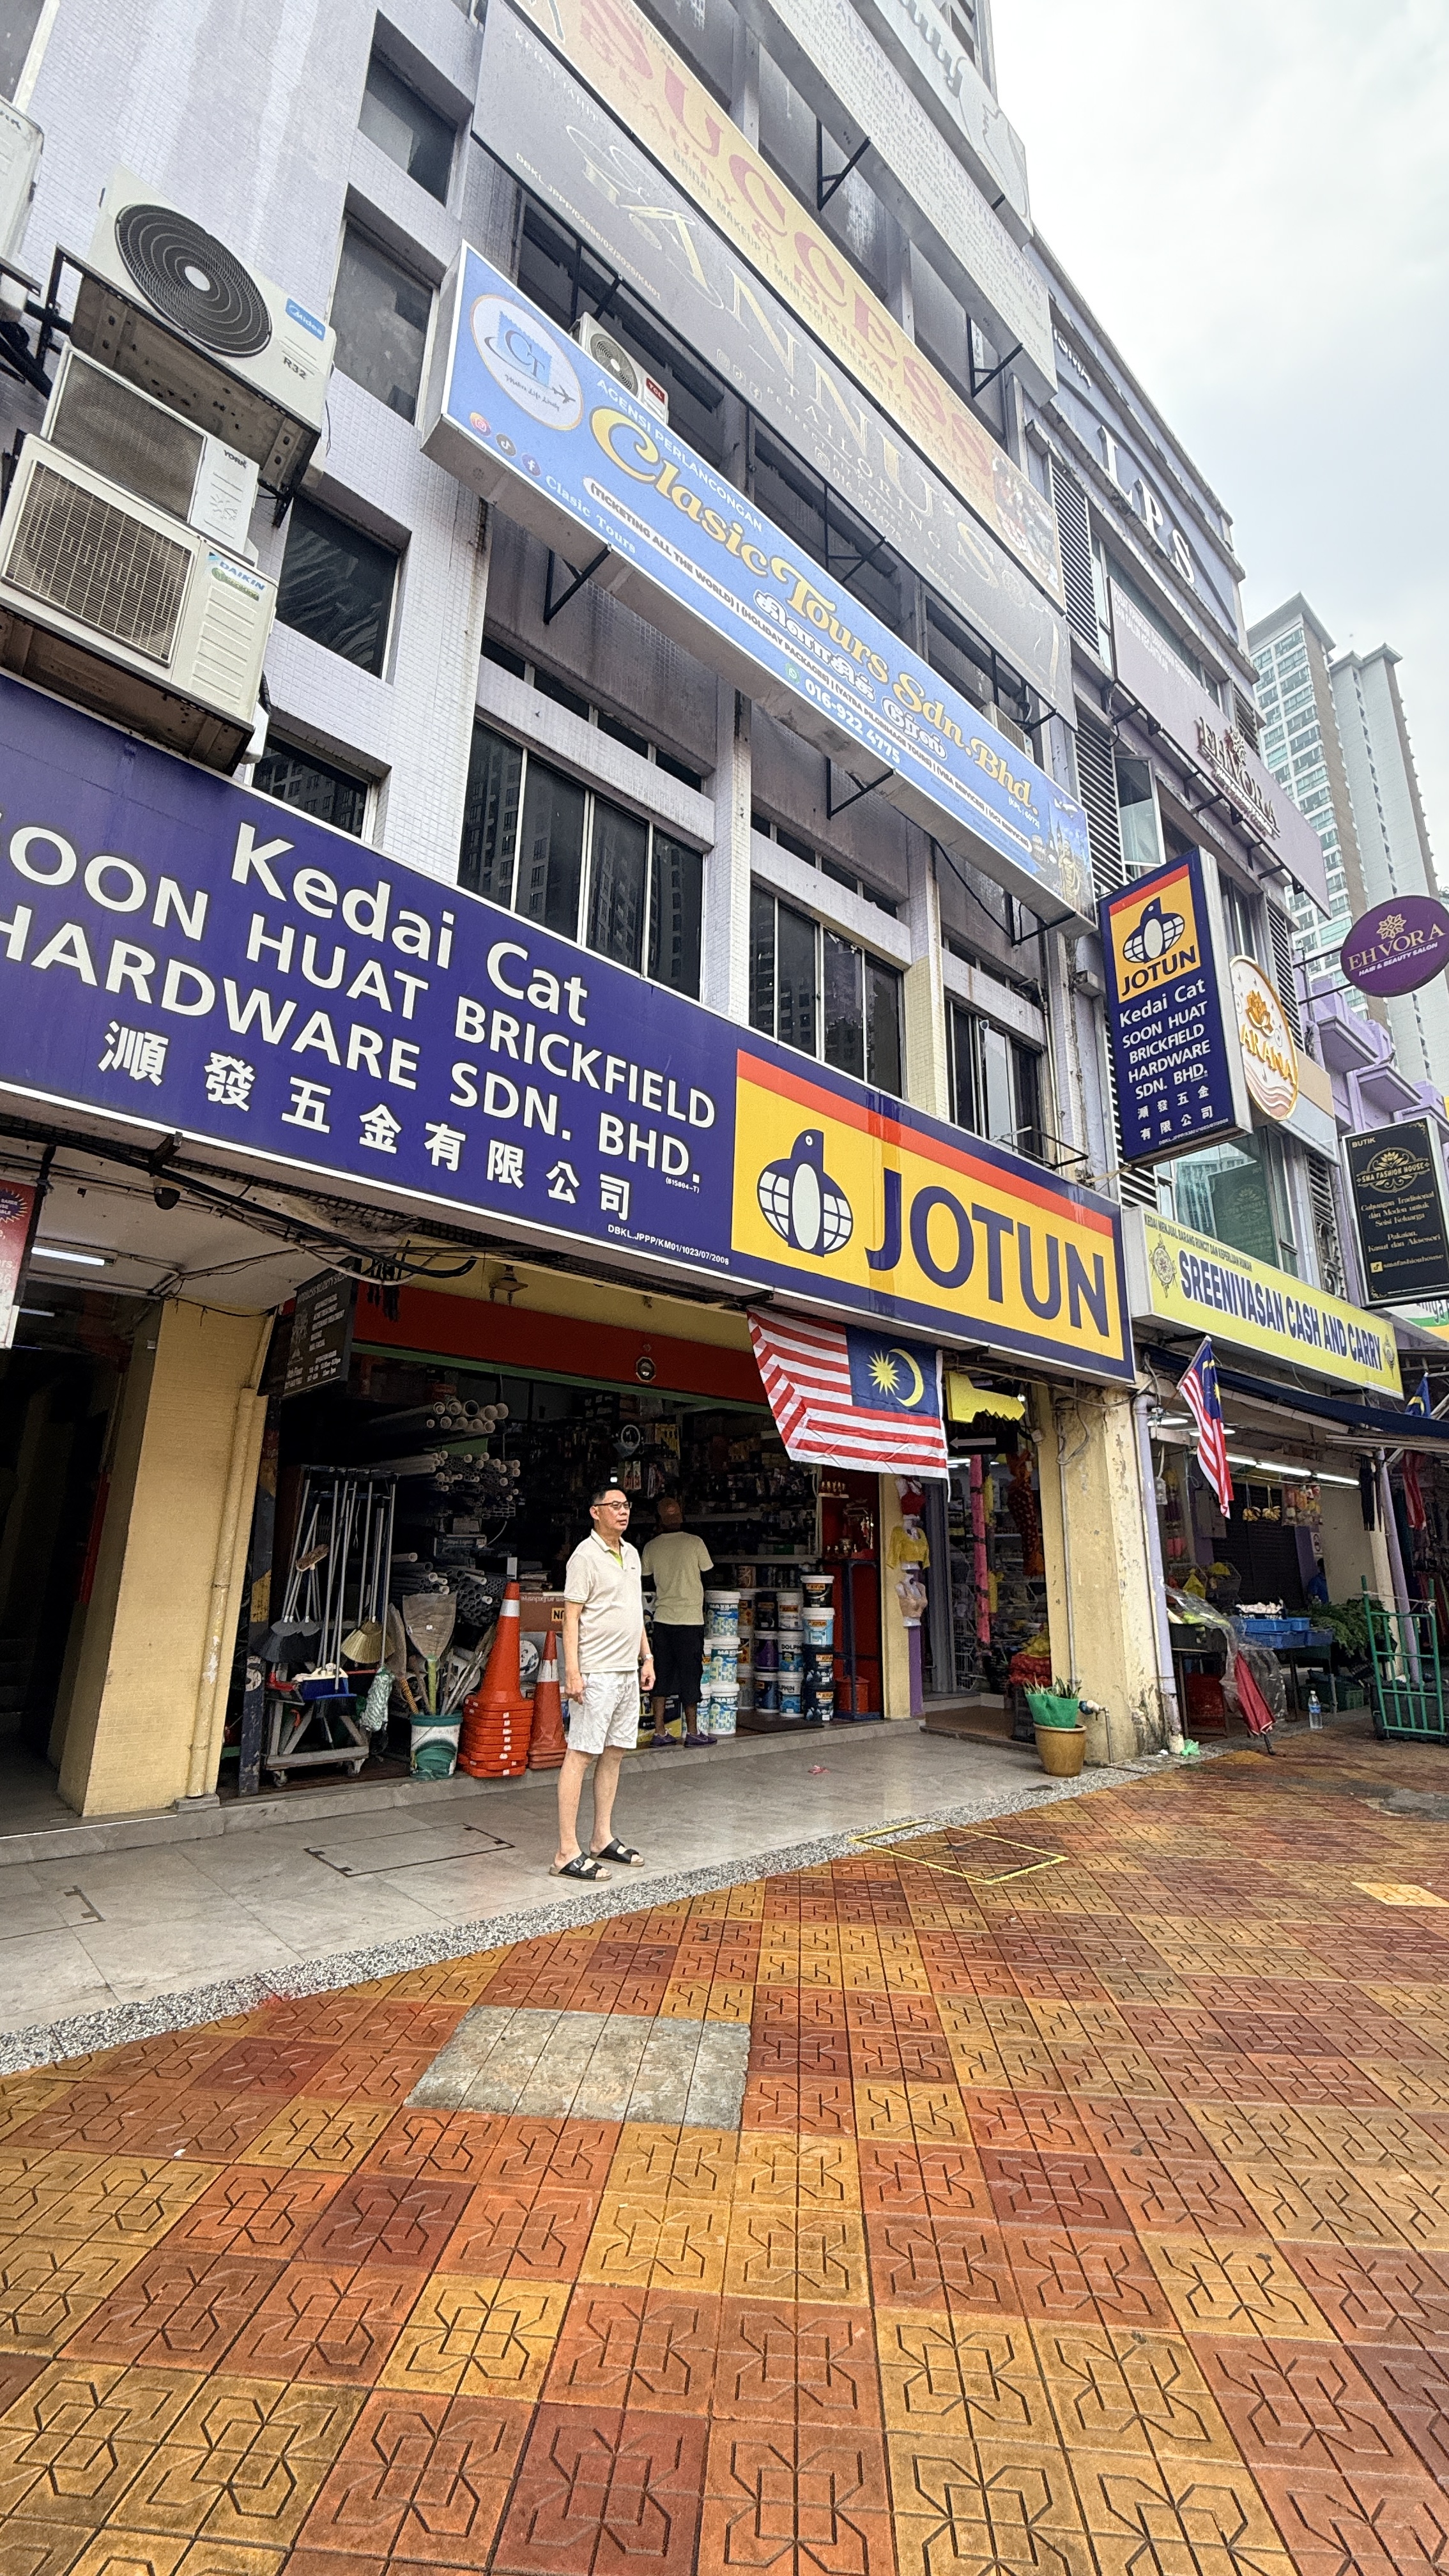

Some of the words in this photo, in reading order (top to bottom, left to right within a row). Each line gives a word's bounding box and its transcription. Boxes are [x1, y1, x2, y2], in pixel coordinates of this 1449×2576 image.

[578, 13, 737, 213] BEAUTY
[751, 213, 780, 264] &
[793, 262, 900, 402] BRIDAL
[672, 147, 712, 201] BRIDAL
[716, 196, 761, 256] MAKEUP
[578, 0, 991, 477] SUCCESS
[290, 305, 323, 336] Midea
[283, 356, 307, 379] R32
[648, 381, 665, 402] TCL
[224, 449, 248, 469] YORK
[596, 375, 651, 434] AGENSI
[657, 429, 762, 534] PERLANCONGAN
[784, 376, 940, 552] TAILORING
[545, 473, 590, 519] Clasic
[595, 513, 636, 556] Tours
[589, 386, 768, 594] Clasic
[770, 547, 888, 690] Tours
[219, 561, 266, 591] DAIKIN
[590, 481, 650, 540] (TICKETING
[652, 532, 671, 557] ALL
[673, 549, 693, 575] THE
[694, 567, 734, 608] WORLD)
[741, 605, 783, 648] (HOLIDAY
[755, 583, 874, 705] கிளாசிக்
[805, 677, 862, 736] 016-922
[866, 725, 900, 765] 4775
[1198, 712, 1279, 831] EHVORA
[231, 822, 452, 969] Kedai
[487, 942, 588, 1026] Cat
[0, 815, 208, 941] OON
[247, 914, 428, 1020] HUAT
[455, 996, 716, 1129] BRICKFIELD
[1122, 946, 1197, 997] JOTUN
[1358, 963, 1376, 976] HAIR
[1383, 951, 1413, 967] BEAUTY
[1413, 942, 1438, 956] SALON
[1120, 994, 1168, 1027] Kedai
[1174, 978, 1206, 1002] Cat
[1122, 1021, 1163, 1048] SOON
[1168, 1001, 1208, 1029] HUAT
[0, 905, 420, 1090] HARDWARE
[450, 1062, 571, 1141] SDN.
[599, 1112, 700, 1184] BHD.
[1128, 1039, 1211, 1083] HARDWARE
[1130, 1023, 1205, 1064] BRICKFIELD
[1135, 1077, 1168, 1100] SDN.
[1174, 1063, 1208, 1085] BHD.
[1140, 1105, 1214, 1140] 有限公司
[1352, 1137, 1376, 1149] BUTIK
[1376, 1168, 1402, 1181] FASHION
[1397, 1190, 1435, 1204] Tradisional
[1368, 1209, 1381, 1220] dan
[1409, 1201, 1430, 1212] untuk
[1393, 1213, 1425, 1225] Keluarga
[607, 1223, 730, 1266] DBKL.JPPP/KM01/1023/07/2008
[864, 1167, 1110, 1337] JOTUN
[1367, 1243, 1389, 1253] Kasut
[1390, 1239, 1404, 1249] dan
[1407, 1234, 1441, 1246] Aksesori
[1383, 1254, 1444, 1269] smafashionhouse
[1179, 1250, 1285, 1334] SREENIVASAN
[1285, 1296, 1322, 1347] CASH
[1322, 1312, 1347, 1357] AND
[1347, 1322, 1383, 1371] CARRY
